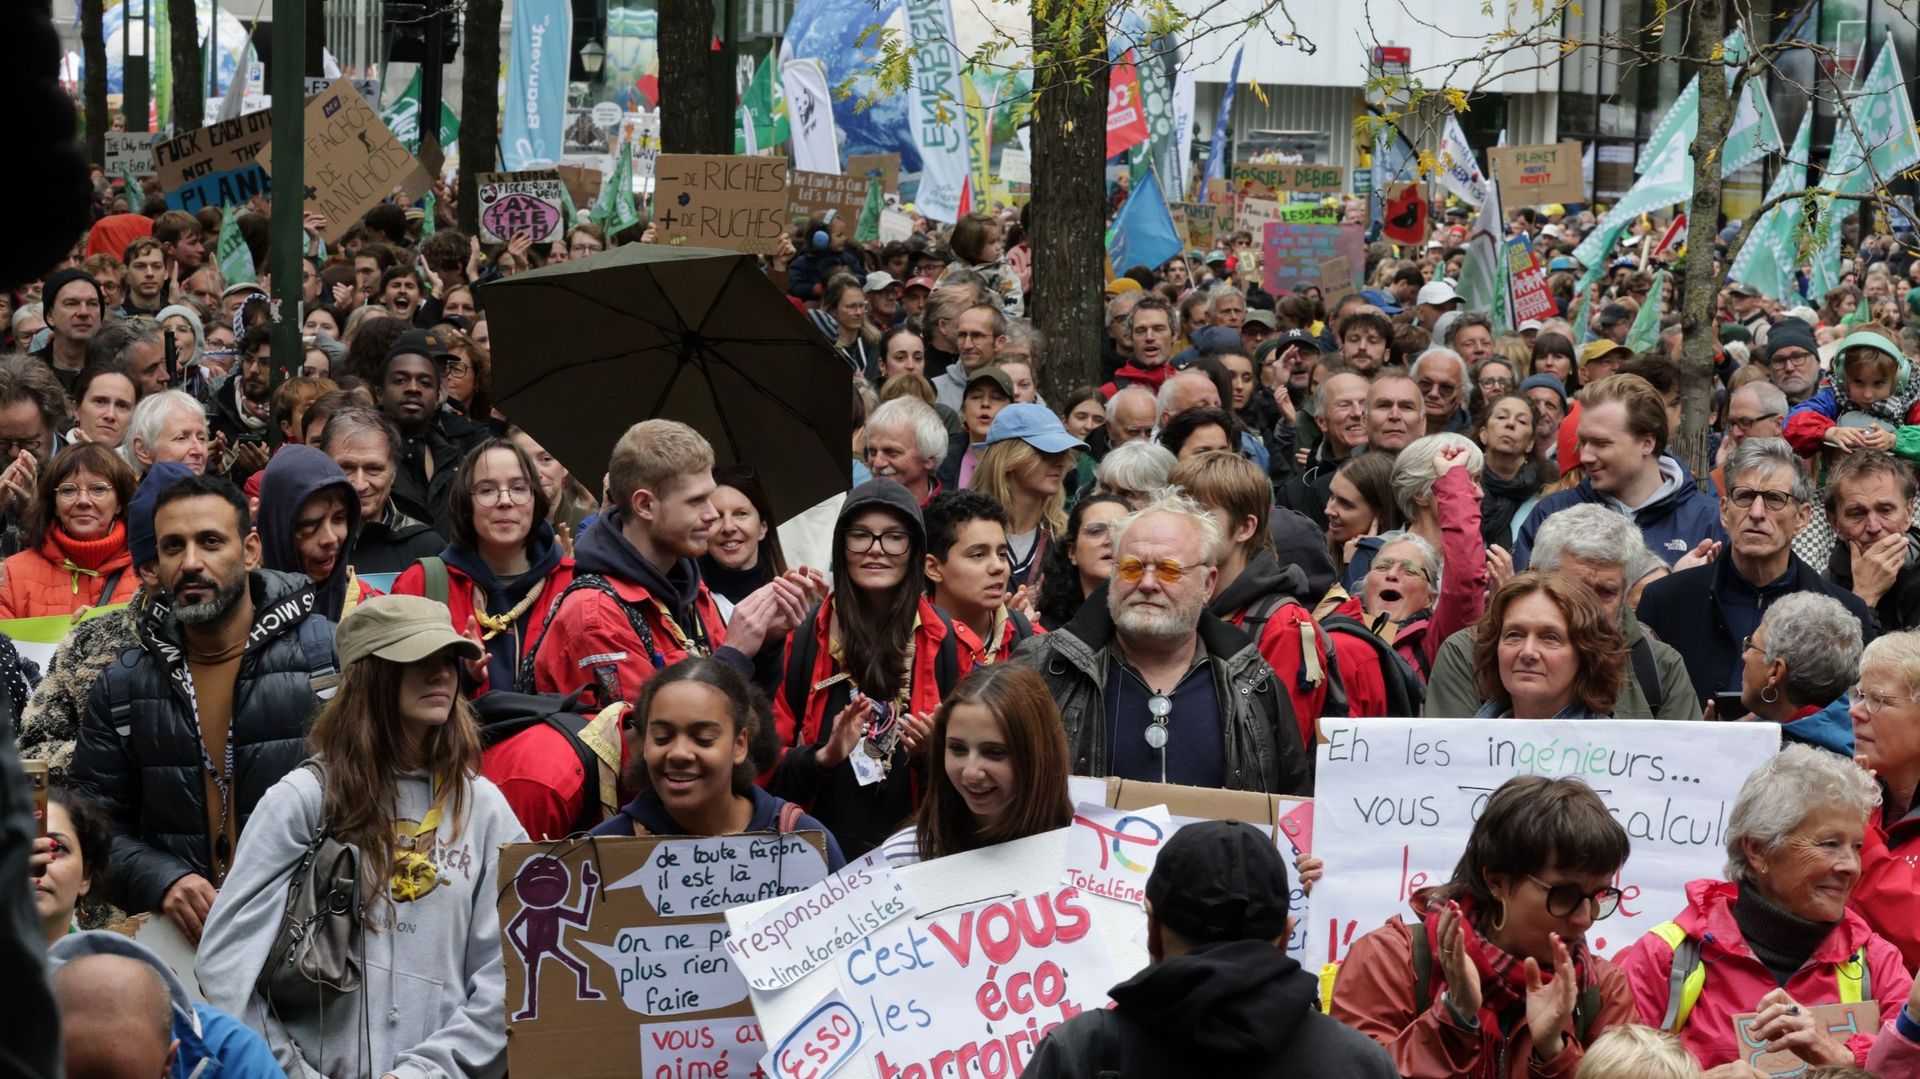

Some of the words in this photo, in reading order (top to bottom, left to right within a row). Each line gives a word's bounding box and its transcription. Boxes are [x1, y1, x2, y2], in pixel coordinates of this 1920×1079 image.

[156, 131, 201, 167] FUCK
[208, 118, 243, 147] EACH
[1515, 149, 1558, 164] PLANET
[182, 158, 213, 182] NOT
[231, 142, 262, 162] THE
[317, 162, 342, 187] DE
[684, 172, 698, 187] DE
[704, 161, 786, 192] RICHES
[1295, 167, 1341, 188] DEBIEL
[181, 166, 272, 213] PLANE
[492, 197, 541, 213] TAX
[491, 210, 547, 225] THE
[681, 212, 696, 227] DE
[701, 206, 783, 239] RUCHES
[245, 599, 301, 648] MICH
[1328, 726, 1368, 763] Eh
[1406, 727, 1450, 767] les
[1353, 795, 1440, 827] vous
[1608, 797, 1729, 846] alcul
[656, 845, 681, 868] de
[694, 841, 737, 864] toute
[750, 838, 807, 863] façon
[658, 875, 669, 893] il
[682, 872, 714, 888] est
[730, 863, 751, 882] là
[1066, 868, 1146, 902] TotalEne
[1400, 845, 1429, 901] le
[657, 895, 674, 916] le
[618, 933, 650, 953] On
[665, 931, 691, 949] ne
[848, 925, 935, 986] c'est
[928, 887, 1091, 969] VOUS
[620, 964, 667, 995] plus
[684, 957, 728, 974] rien
[646, 989, 700, 1021] faire
[870, 996, 931, 1038] les
[976, 961, 1067, 1022] éco
[652, 1026, 715, 1050] vous
[656, 1050, 729, 1079] aimé
